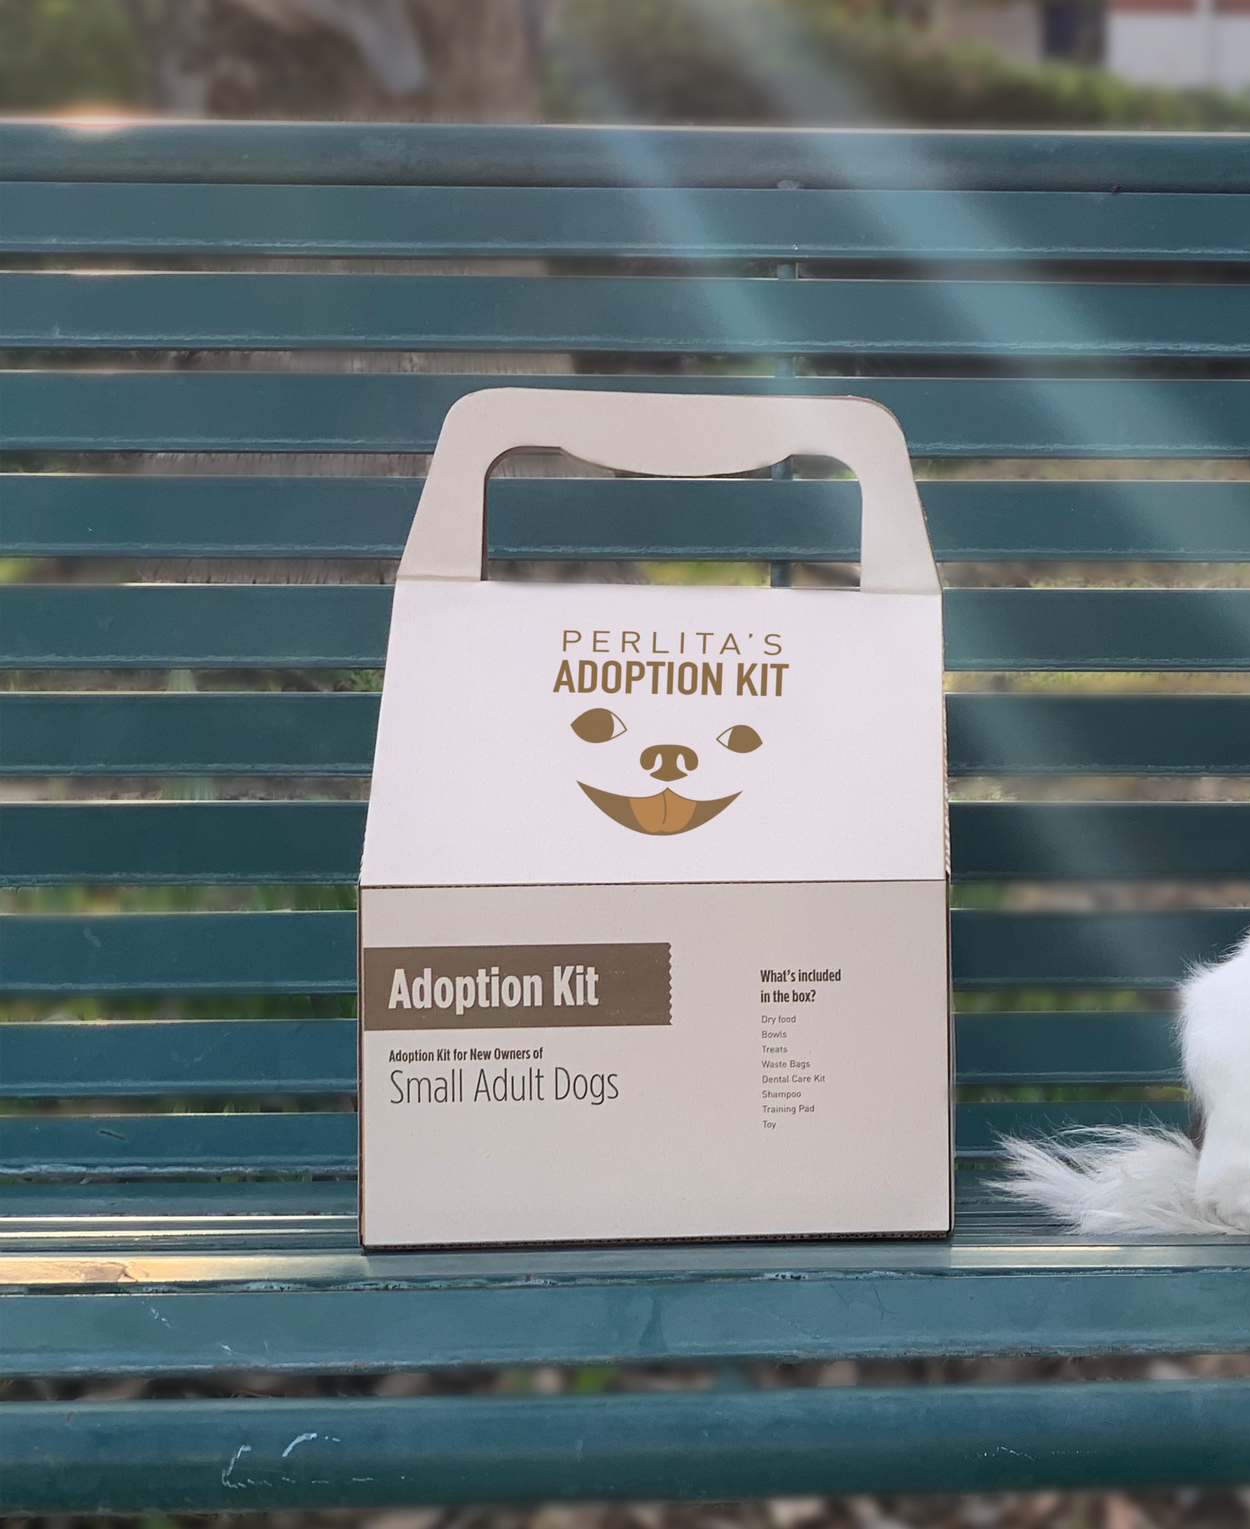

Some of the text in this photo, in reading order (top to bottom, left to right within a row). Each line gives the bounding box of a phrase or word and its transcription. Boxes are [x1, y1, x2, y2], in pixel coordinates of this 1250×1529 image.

[562, 629, 783, 656] PERLITA'S
[552, 659, 790, 697] ADOPTION KIT
[760, 969, 842, 983] What's included
[387, 964, 599, 1016] Adoption Kit
[760, 989, 817, 1003] in the box?
[761, 1015, 797, 1025] Dry food
[761, 1030, 787, 1039] Bowls
[761, 1045, 788, 1053] Treats
[388, 1046, 544, 1064] Adoption Kit for New Owners of
[761, 1060, 811, 1070] Waste Bags
[761, 1074, 826, 1083] Dental Care Kit
[390, 1066, 620, 1105] Small Adult Dogs
[761, 1090, 802, 1099] Shampoo
[762, 1104, 815, 1115] Training Pad
[762, 1120, 777, 1130] Toy
